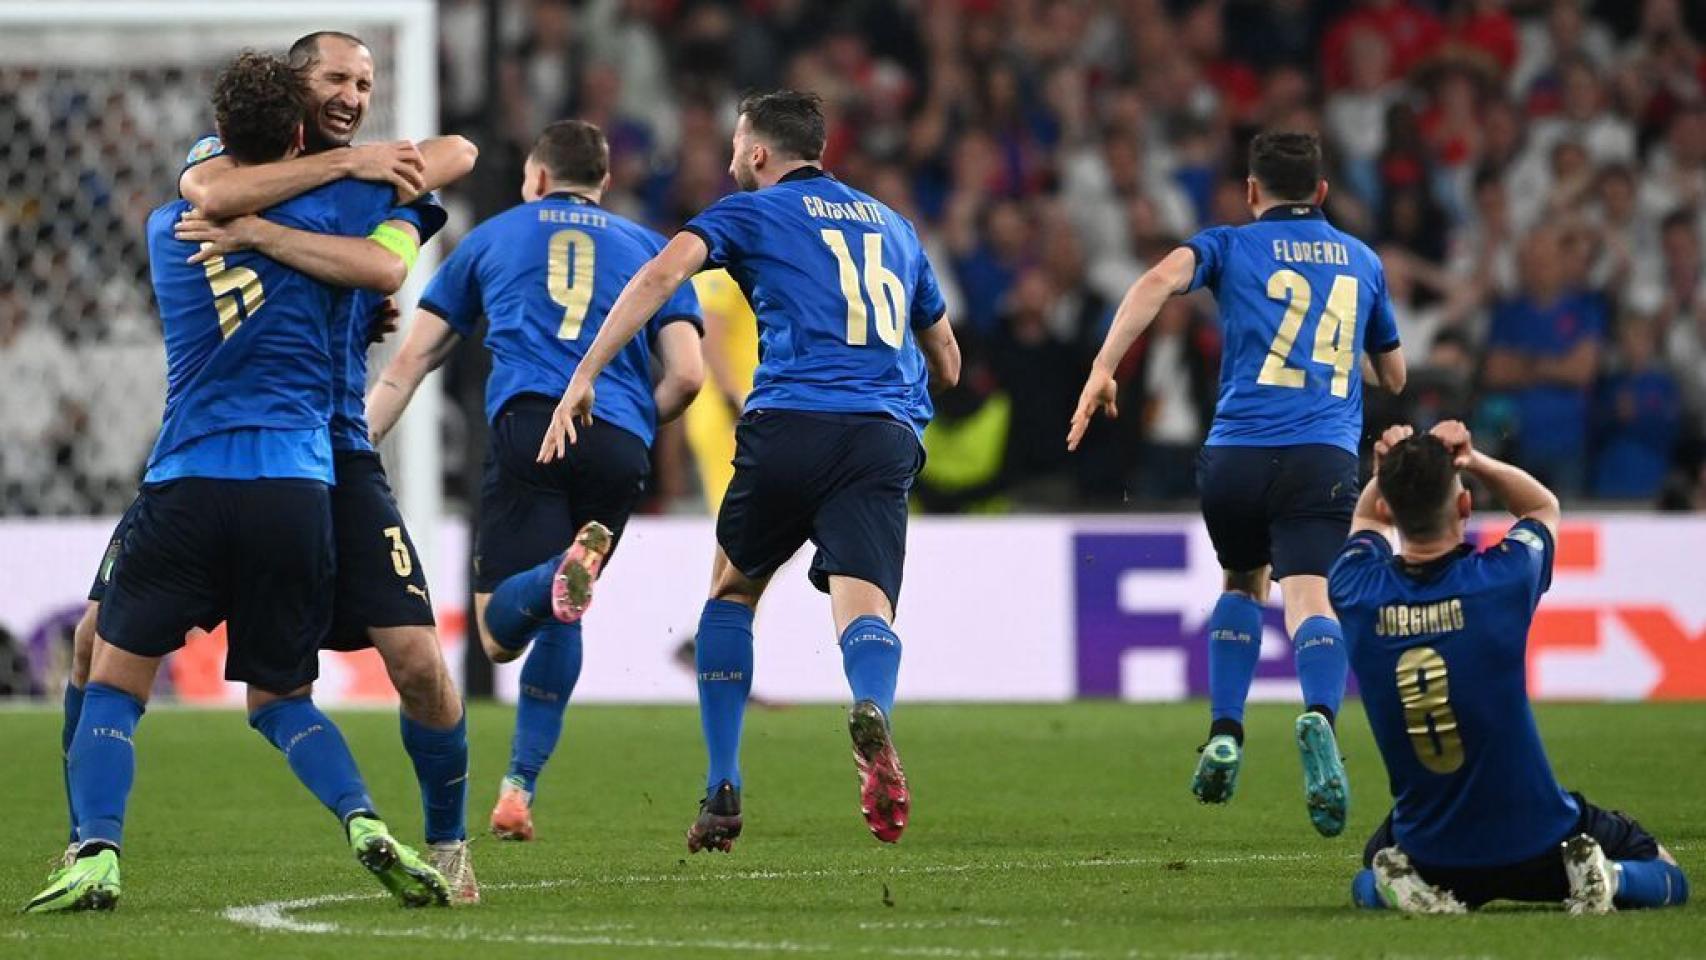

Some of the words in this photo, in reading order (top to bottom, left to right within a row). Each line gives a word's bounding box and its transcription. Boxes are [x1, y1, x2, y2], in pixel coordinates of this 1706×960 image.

[539, 208, 607, 228] BELOTTI
[802, 195, 886, 226] CRISTANTE
[1272, 239, 1350, 266] FLORENZI
[547, 229, 597, 341] 9
[820, 229, 906, 349] 16
[1255, 269, 1359, 400] 24
[383, 526, 412, 577] 3
[1375, 598, 1465, 637] JORGINHO
[1396, 646, 1466, 774] 8
